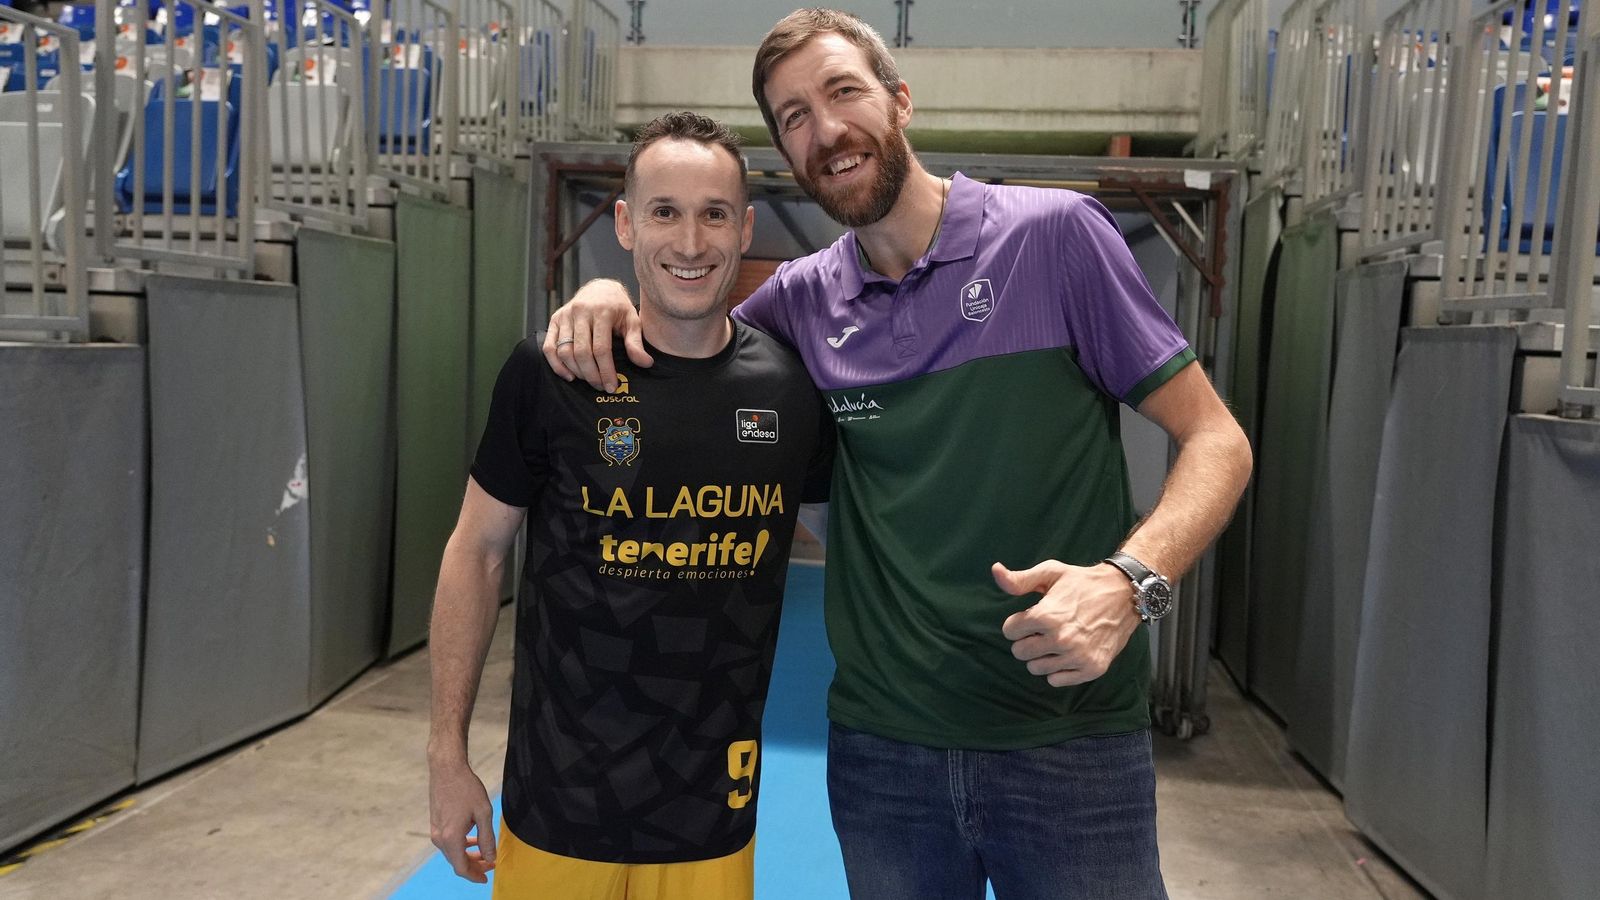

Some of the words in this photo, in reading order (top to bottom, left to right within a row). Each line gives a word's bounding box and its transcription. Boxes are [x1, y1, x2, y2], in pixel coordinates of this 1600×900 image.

[741, 419, 758, 430] liga
[741, 429, 775, 439] endesa
[581, 486, 634, 518] LA
[645, 483, 784, 519] LAGUNA
[600, 529, 770, 576] tenerife!
[598, 564, 671, 580] despierta
[677, 568, 749, 580] emociones
[727, 739, 758, 809] 9
